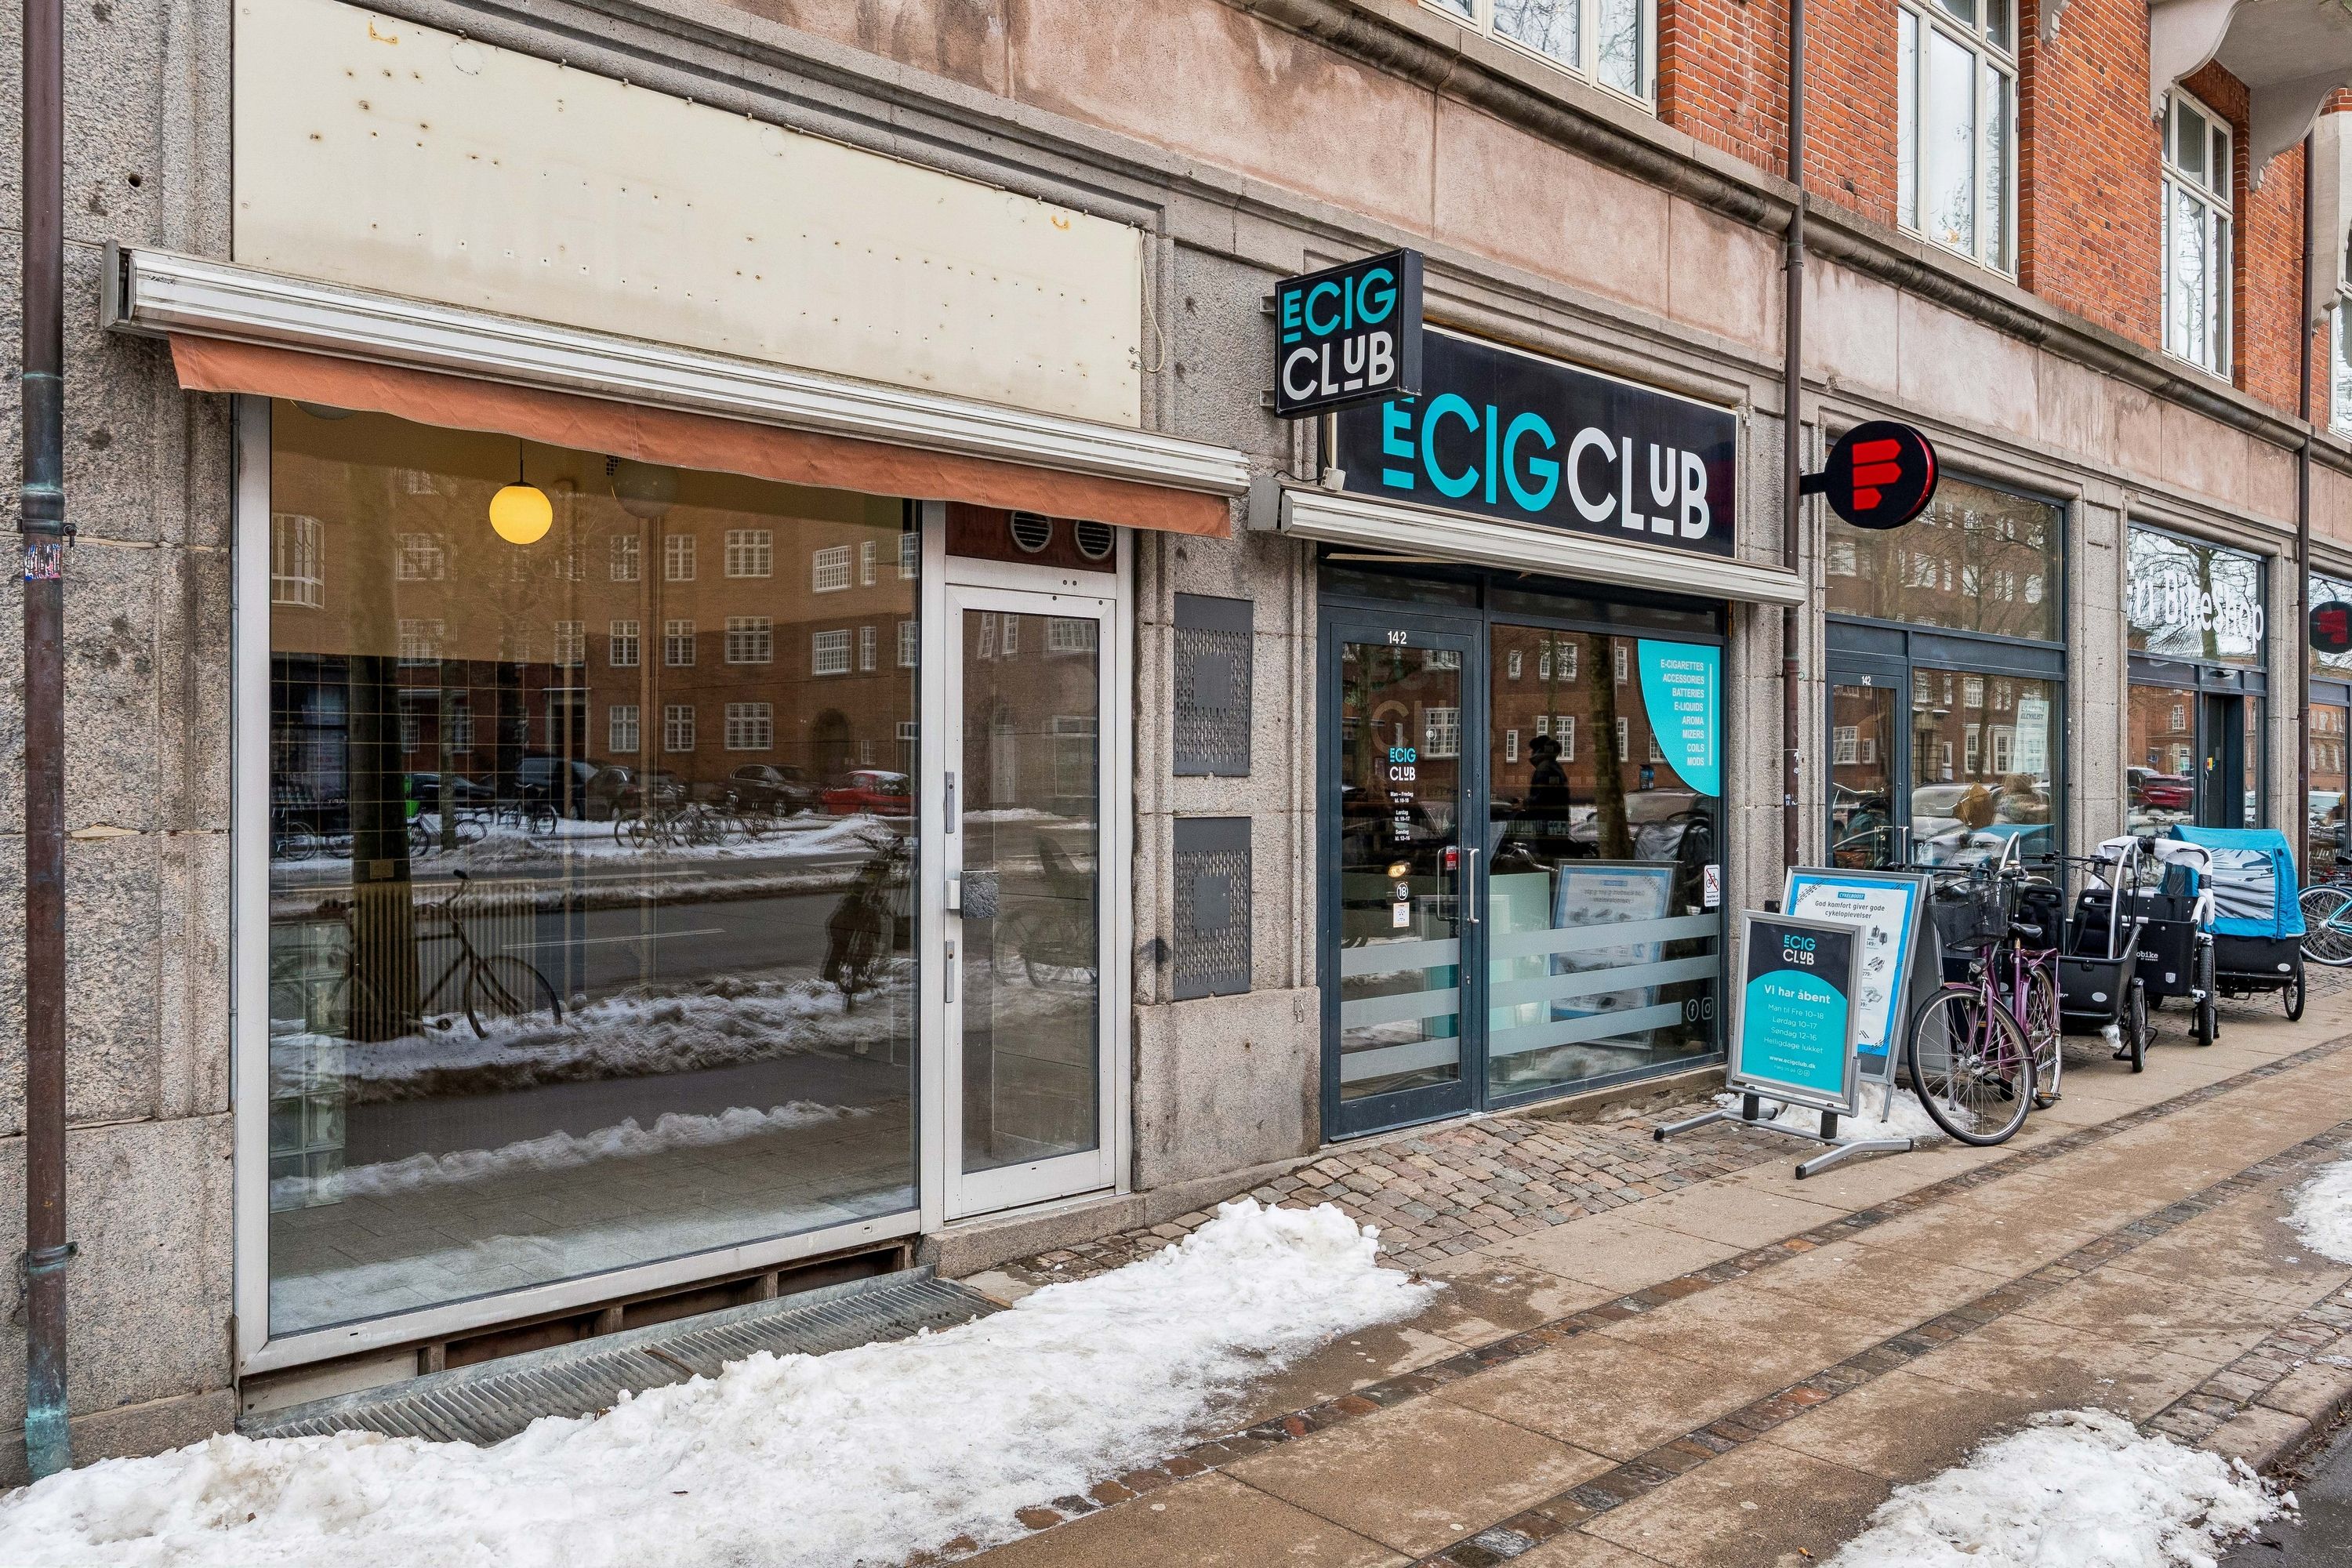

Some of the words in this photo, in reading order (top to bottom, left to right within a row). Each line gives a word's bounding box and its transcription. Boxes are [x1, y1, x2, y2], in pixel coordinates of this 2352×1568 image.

[1283, 267, 1396, 344] ECIG
[1283, 331, 1396, 401] CLUB
[1388, 630, 1407, 644] 142
[1661, 659, 1704, 671] E-CIGARETTES
[1663, 673, 1705, 684] ACCESSORIES
[1861, 675, 1871, 686] 142
[1672, 688, 1704, 699] BATTERIES
[1674, 702, 1704, 712] E-LIQUIDS
[1682, 716, 1704, 725] AROMA
[1682, 730, 1704, 739] MIZERS
[1687, 743, 1704, 753] COILS
[1390, 748, 1416, 763] ECIG
[1687, 757, 1704, 766] MODS
[1389, 766, 1416, 781] CLUB
[1398, 886, 1406, 897] 18
[1825, 910, 1871, 919] cykeloplevelser
[1784, 935, 1816, 951] ECIG
[1783, 949, 1814, 965] CLUB
[1764, 985, 1775, 994] Vi
[1778, 986, 1795, 998] har
[1798, 989, 1831, 1004] åbent
[1772, 1016, 1796, 1027] Lørdag
[1770, 1026, 1797, 1038] Søndag
[1763, 1036, 1800, 1050] Helligdage
[1802, 1044, 1824, 1054] lukket
[1769, 1055, 1817, 1069] www.ecigclub.dk
